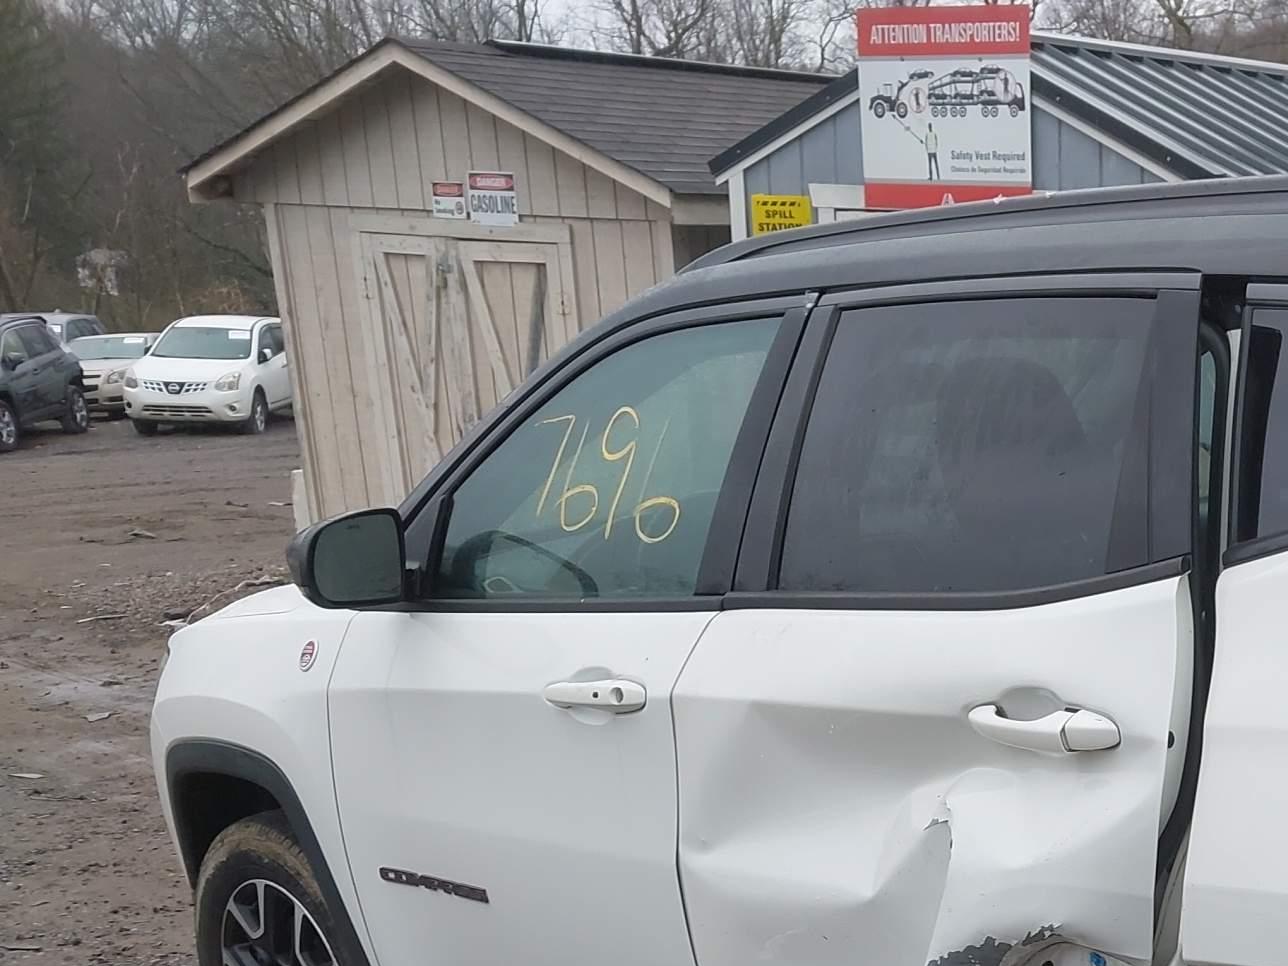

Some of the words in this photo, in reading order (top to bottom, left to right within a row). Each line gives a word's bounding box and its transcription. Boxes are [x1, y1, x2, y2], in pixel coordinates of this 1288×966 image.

[870, 23, 927, 45] ATTENTION
[929, 21, 1020, 43] TRANSPORTERS!
[951, 150, 973, 162] Safety
[975, 149, 990, 161] Vest
[470, 194, 516, 214] GASOLINE
[764, 209, 795, 219] SPILL
[534, 405, 680, 544] 7696
